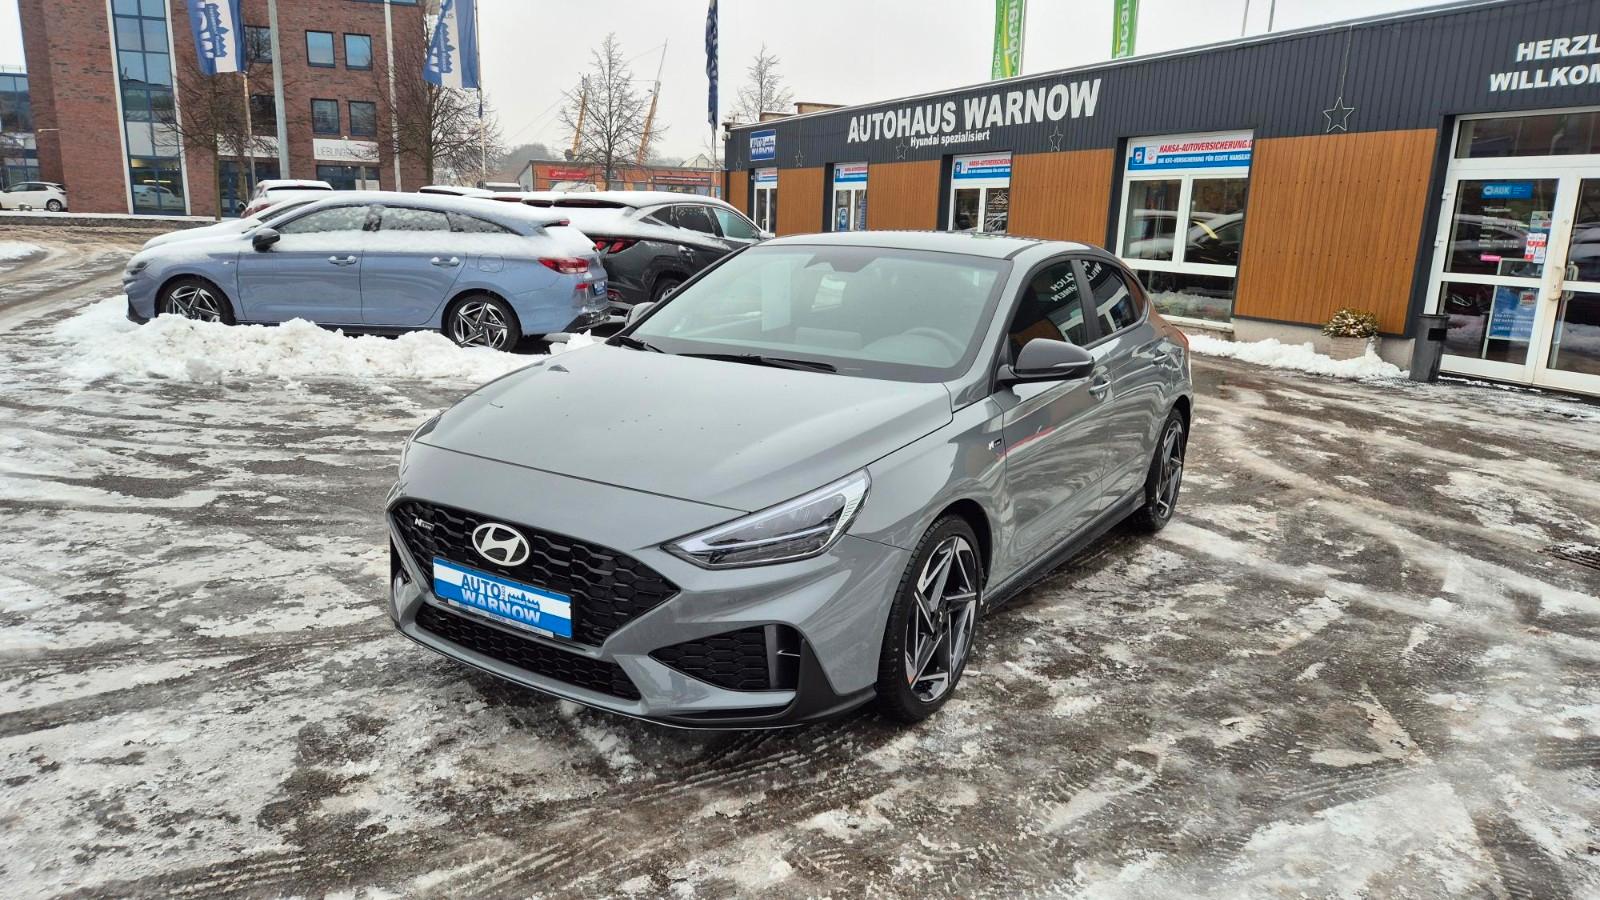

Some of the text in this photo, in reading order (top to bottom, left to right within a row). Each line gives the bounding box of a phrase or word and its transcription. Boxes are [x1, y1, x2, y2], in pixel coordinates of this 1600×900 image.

[1516, 33, 1600, 62] HERZL
[847, 78, 1101, 144] AUTOHAUS WARNOW
[910, 129, 990, 149] Hyundai spezialisiert
[461, 574, 501, 598] AUTO
[461, 588, 540, 623] WARNOW
